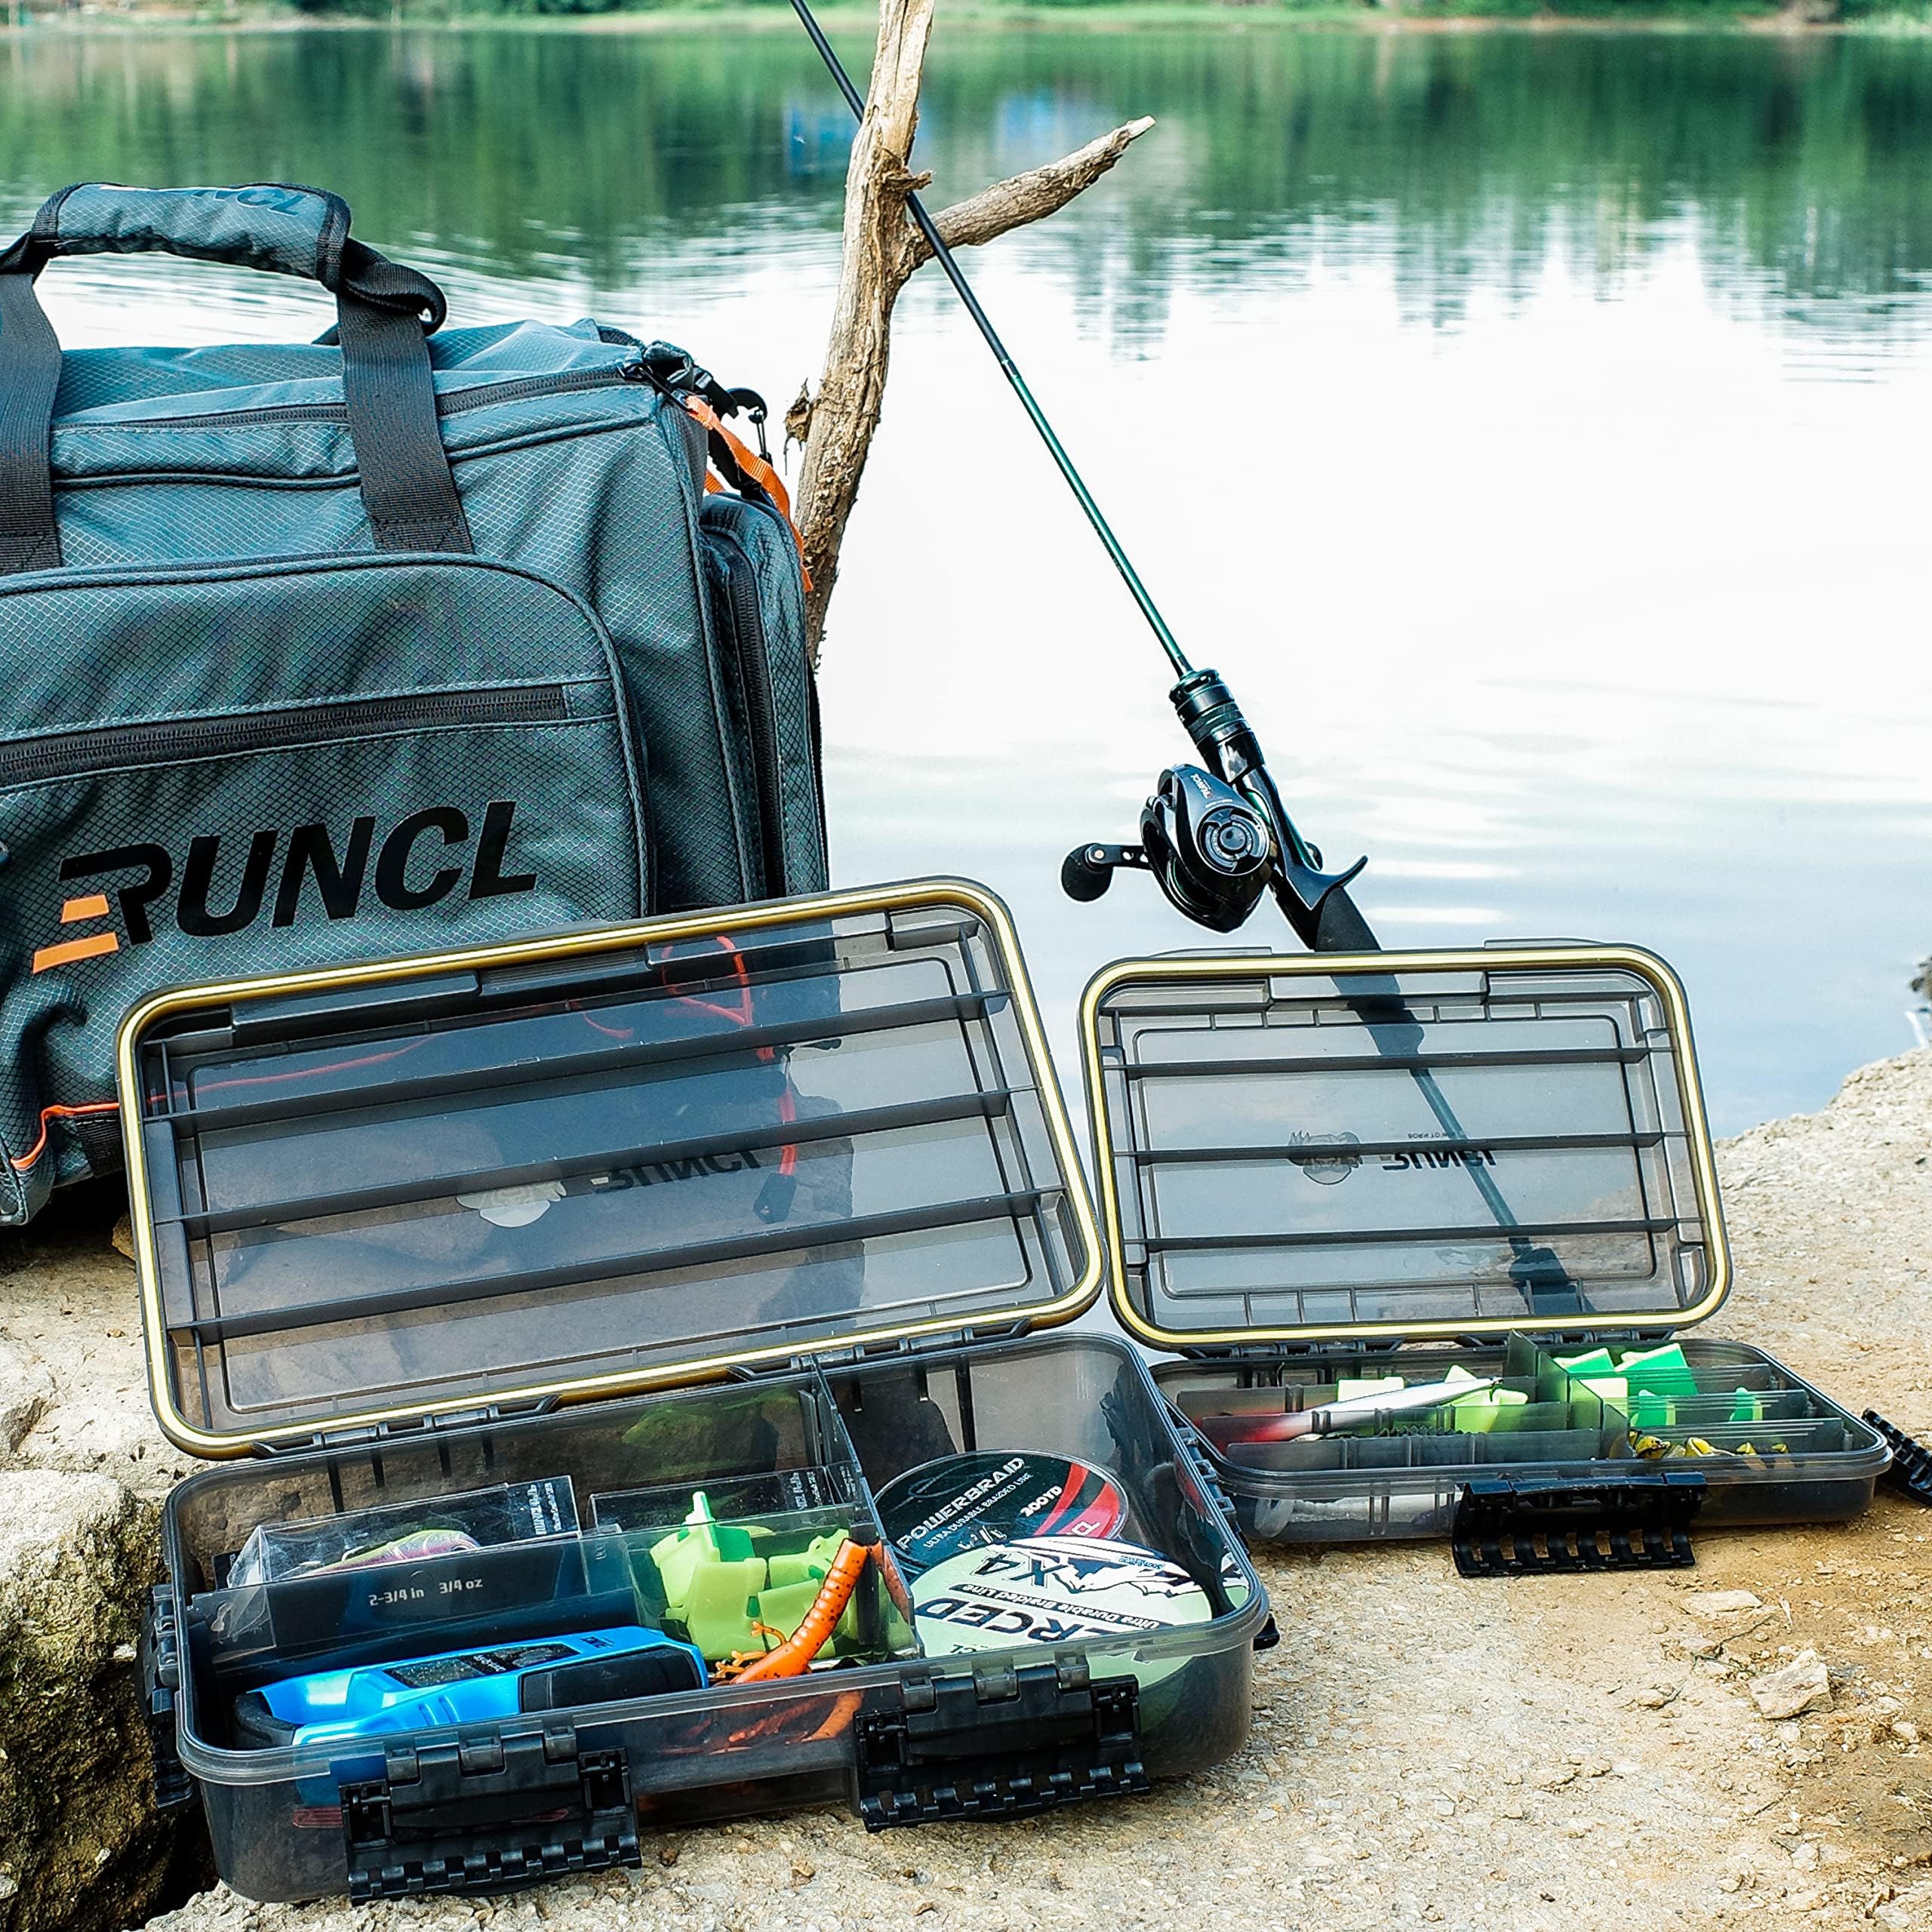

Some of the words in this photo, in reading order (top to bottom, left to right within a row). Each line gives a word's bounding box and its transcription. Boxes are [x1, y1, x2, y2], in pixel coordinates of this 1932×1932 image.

[33, 801, 537, 974] RUNCL
[896, 1457, 1025, 1550] POWERBRAID
[971, 1552, 1069, 1588] X4
[368, 1589, 408, 1606] 2-3/4
[411, 1587, 424, 1599] in
[438, 1579, 463, 1594] 3/4
[465, 1578, 483, 1589] oz
[963, 1584, 997, 1597] Line
[995, 1590, 1057, 1610] Braided
[915, 1598, 1121, 1642] RCED
[1058, 1602, 1120, 1623] Durable
[1121, 1615, 1160, 1629] Ultra
